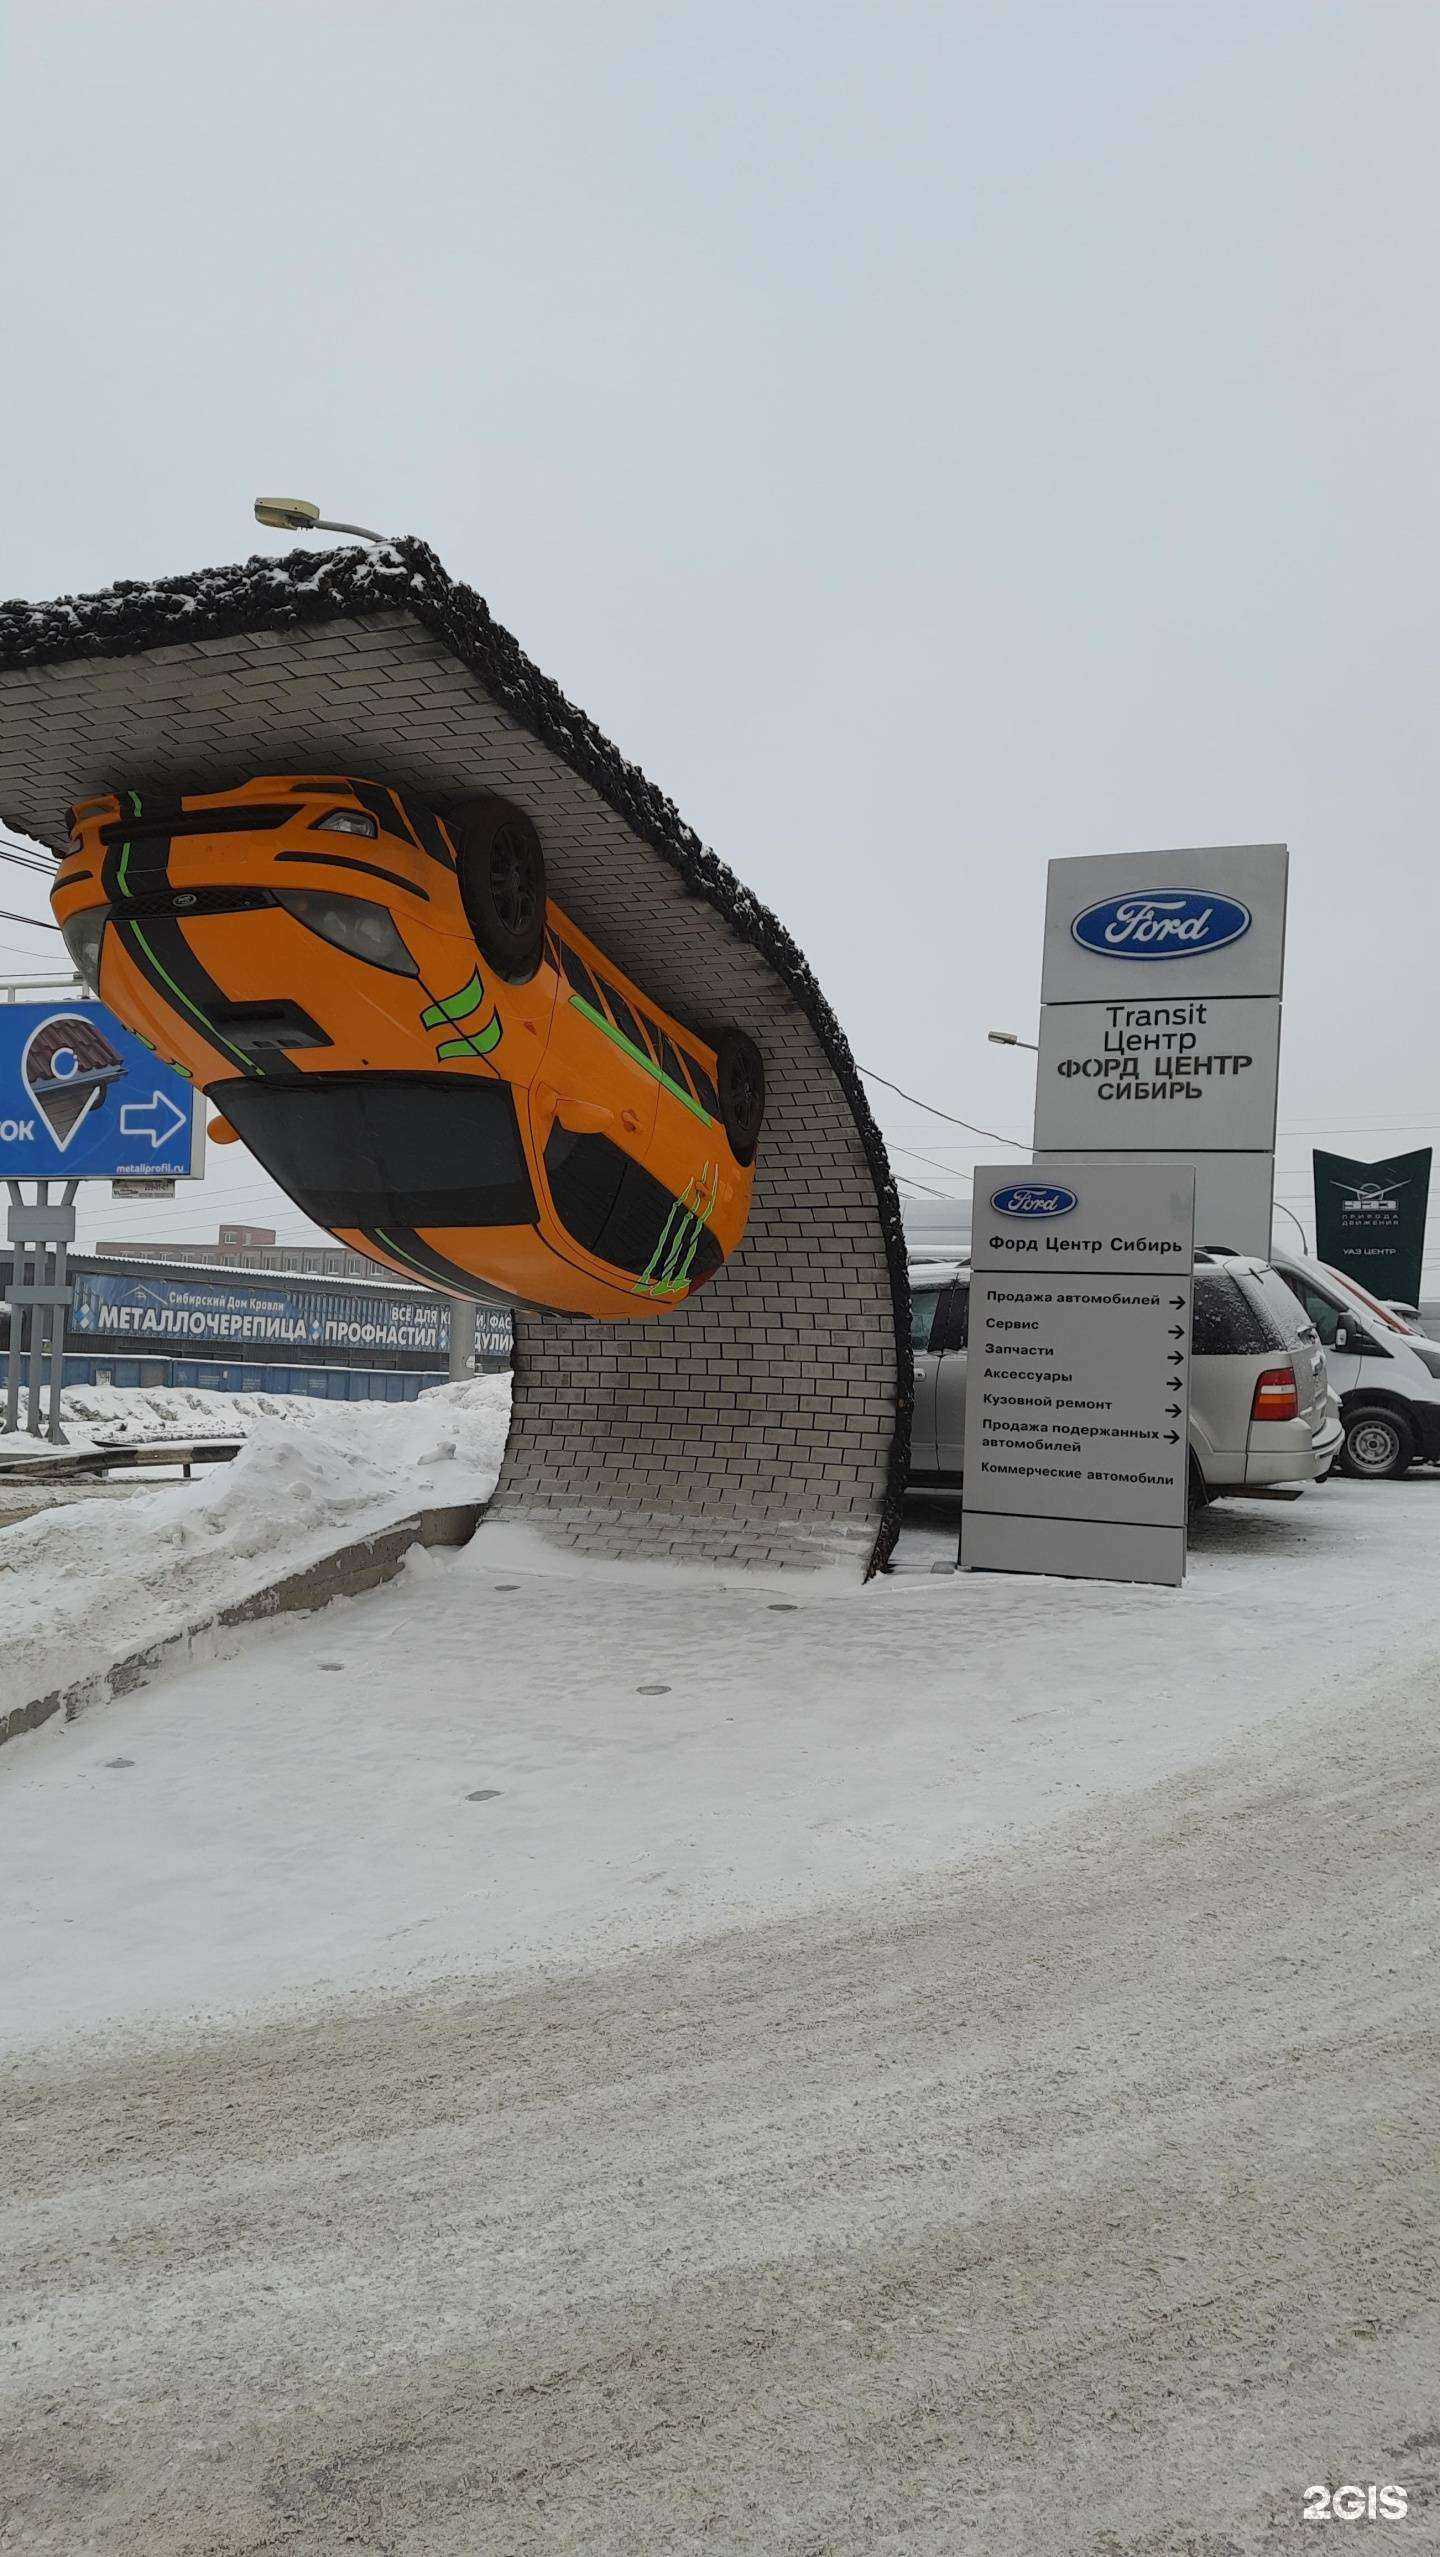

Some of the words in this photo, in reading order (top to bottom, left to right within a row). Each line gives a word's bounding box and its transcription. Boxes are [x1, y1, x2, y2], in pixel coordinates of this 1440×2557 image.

[1105, 900, 1213, 943] Ford
[1106, 1003, 1207, 1027] Transit
[1104, 1031, 1196, 1055] Центр
[1057, 1057, 1140, 1080] ФОРД
[1155, 1055, 1253, 1079] ЦЕНТР
[1098, 1081, 1202, 1101] СИБИРЬ
[0, 1120, 35, 1141] ОК
[116, 1163, 184, 1174] metallprofil.ru
[1008, 1189, 1058, 1211] Ford
[989, 1236, 1038, 1252] Форд
[1046, 1237, 1102, 1254] Центр
[1110, 1237, 1182, 1254] Сибирь
[169, 1291, 226, 1307] Сибирский
[227, 1298, 247, 1310] Дом
[249, 1298, 284, 1312] Кровли
[987, 1291, 1052, 1305] Продажа
[1057, 1292, 1160, 1306] автомобилей
[98, 1304, 307, 1342] МЕТАЛЛОЧЕРЕПИЦА
[325, 1320, 436, 1346] ПРОФНАСТИЛ
[415, 1308, 437, 1325] ДЛЯ
[490, 1315, 512, 1329] ФАС
[985, 1318, 1039, 1331] Сервис
[985, 1343, 1054, 1356] Запчасти
[983, 1368, 1072, 1383] Аксессуары
[983, 1393, 1052, 1407] Кузовной
[1056, 1399, 1112, 1410] ремонт
[982, 1419, 1048, 1433] Продажа
[1052, 1425, 1159, 1440] подержанных
[982, 1437, 1081, 1452] автомобилей
[981, 1462, 1082, 1479] Коммерческие
[1087, 1470, 1174, 1485] автомобили
